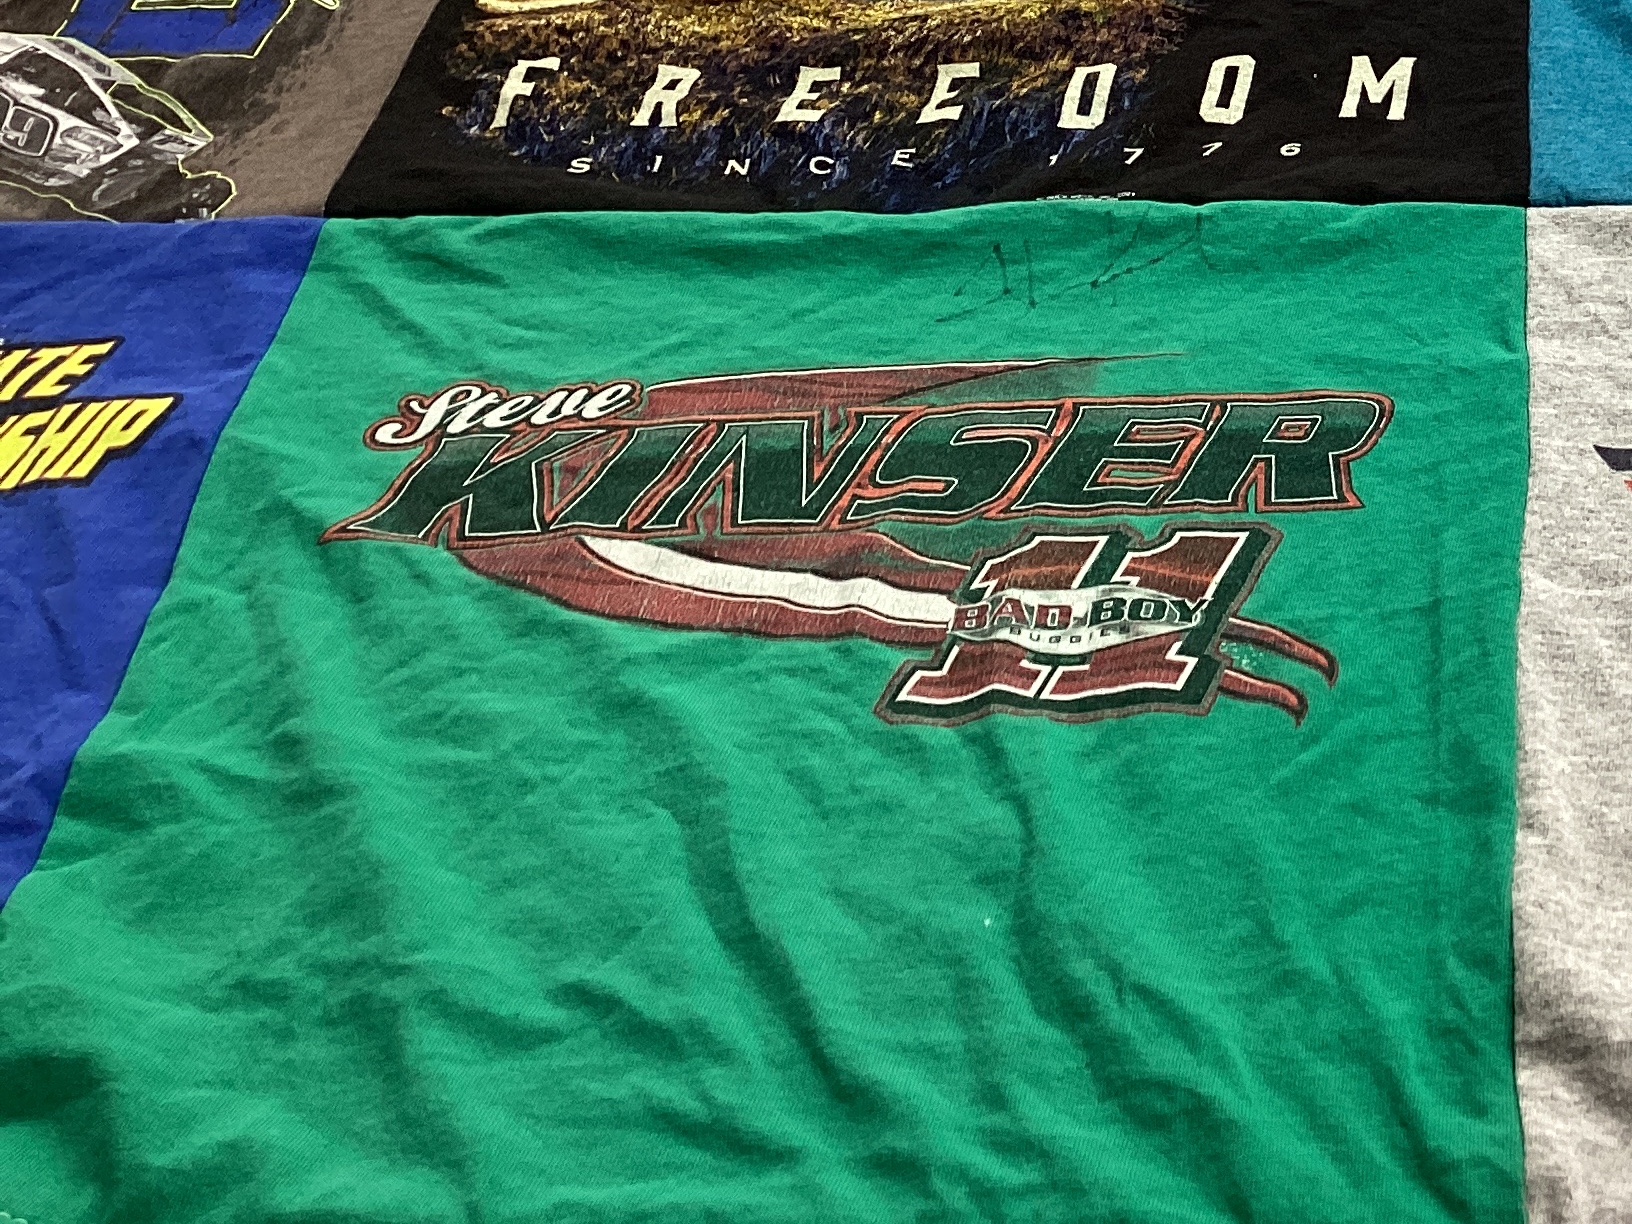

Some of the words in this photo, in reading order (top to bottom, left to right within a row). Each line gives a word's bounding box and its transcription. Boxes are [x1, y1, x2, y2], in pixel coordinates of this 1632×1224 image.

[488, 54, 1419, 132] FREEDOM
[568, 147, 918, 178] SINCE
[1048, 142, 1306, 167] 1776
[0, 396, 175, 490] SHIP
[366, 379, 643, 450] Steve
[321, 389, 1394, 550] KINSER
[876, 526, 1282, 723] 11
[950, 597, 1075, 630] BAD
[1089, 596, 1214, 628] BOY
